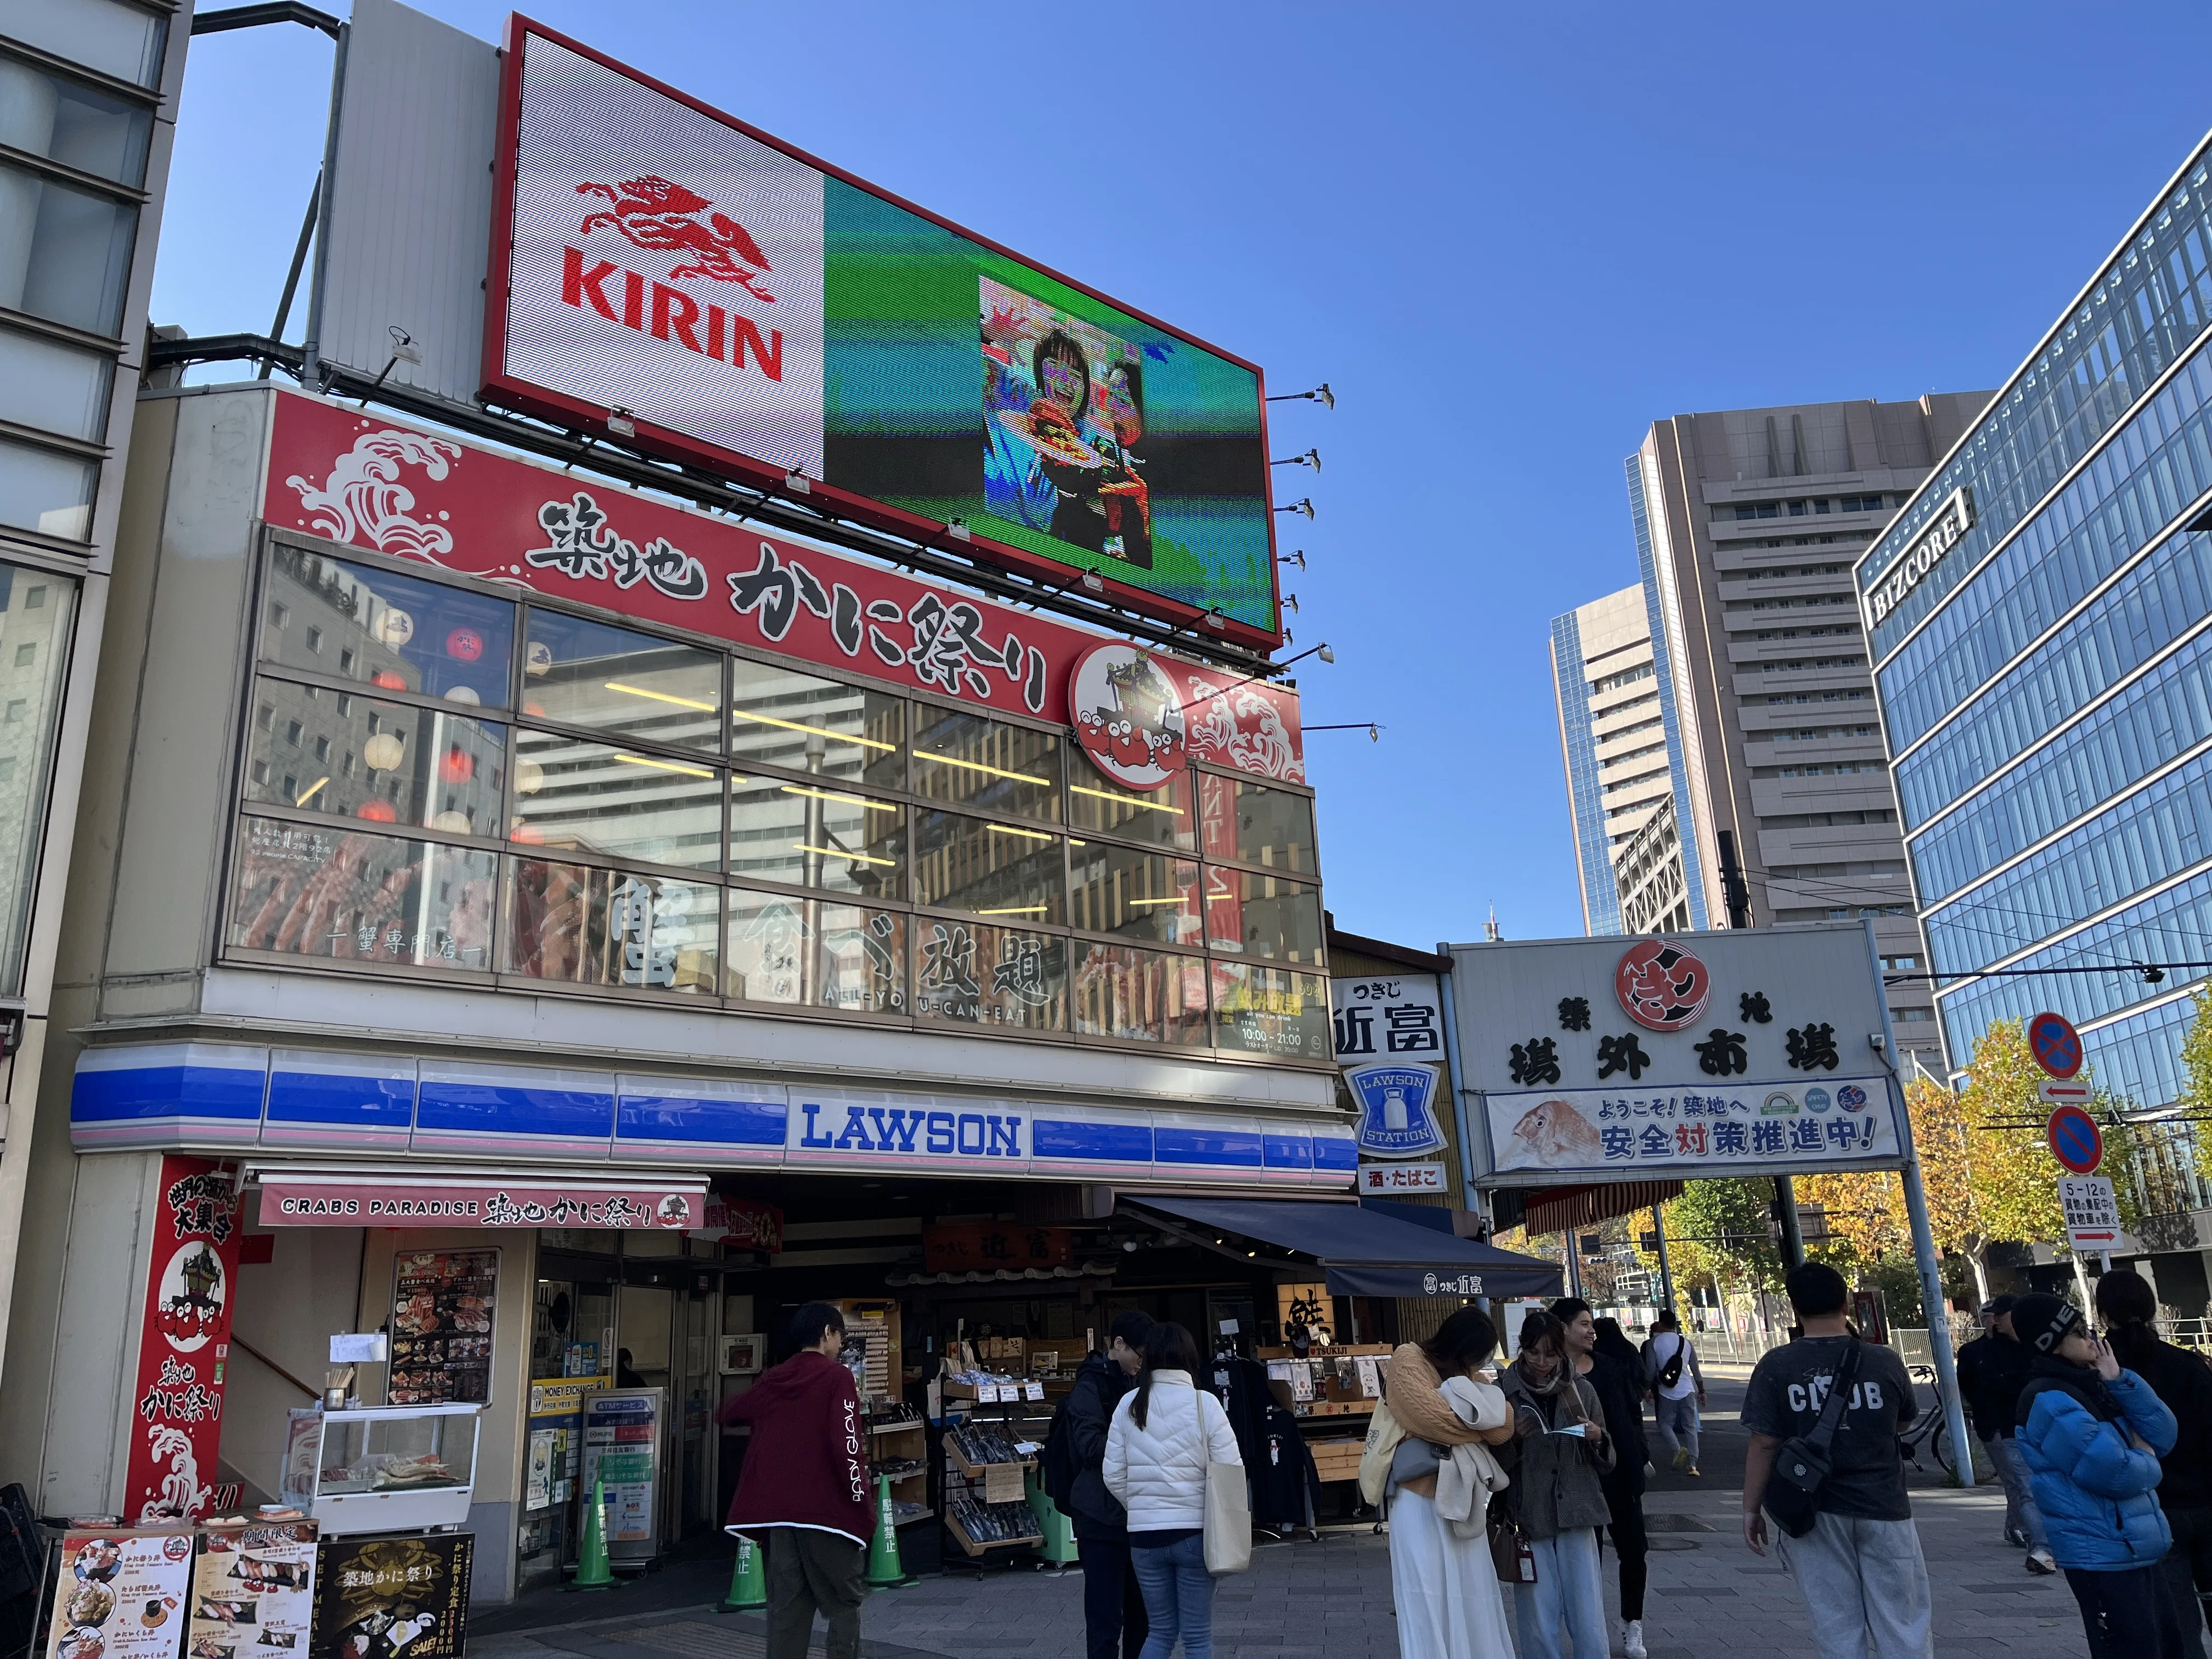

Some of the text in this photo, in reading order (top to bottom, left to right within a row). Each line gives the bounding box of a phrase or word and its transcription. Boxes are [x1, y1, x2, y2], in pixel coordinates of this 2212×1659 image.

[561, 245, 783, 382] KIRIN
[1873, 515, 1957, 622] BIZCORE
[1353, 981, 1401, 1000] つきじ
[1242, 1028, 1267, 1042] 10:00
[1277, 1033, 1301, 1046] 21:00
[1509, 1022, 1839, 1086] 場外市場
[1362, 1075, 1425, 1090] LAWSON
[800, 1103, 1022, 1156] LAWSON
[1366, 1128, 1430, 1143] STATION
[1600, 1115, 1877, 1158] 安全対策推進中!
[281, 1197, 479, 1217] CRABS PARADISE
[2065, 1198, 2114, 1211] 貨物の集配中の
[2067, 1212, 2117, 1226] 貨物車を除く
[1317, 1347, 1348, 1355] TSUKIJI
[158, 1355, 195, 1386] 築地
[544, 1386, 565, 1398] MONEY
[141, 1384, 221, 1422] かに祭り
[598, 1401, 644, 1409] ATMサービス
[844, 1399, 865, 1502] BODY GLOVE
[242, 1526, 297, 1543] 期間限定
[882, 1498, 896, 1553] 駐輪禁止
[343, 1565, 432, 1588] 築地かに祭り
[448, 1543, 464, 1609] かに祭り定食
[309, 1550, 326, 1643] SET MEAL
[409, 1636, 437, 1656] SALE!
